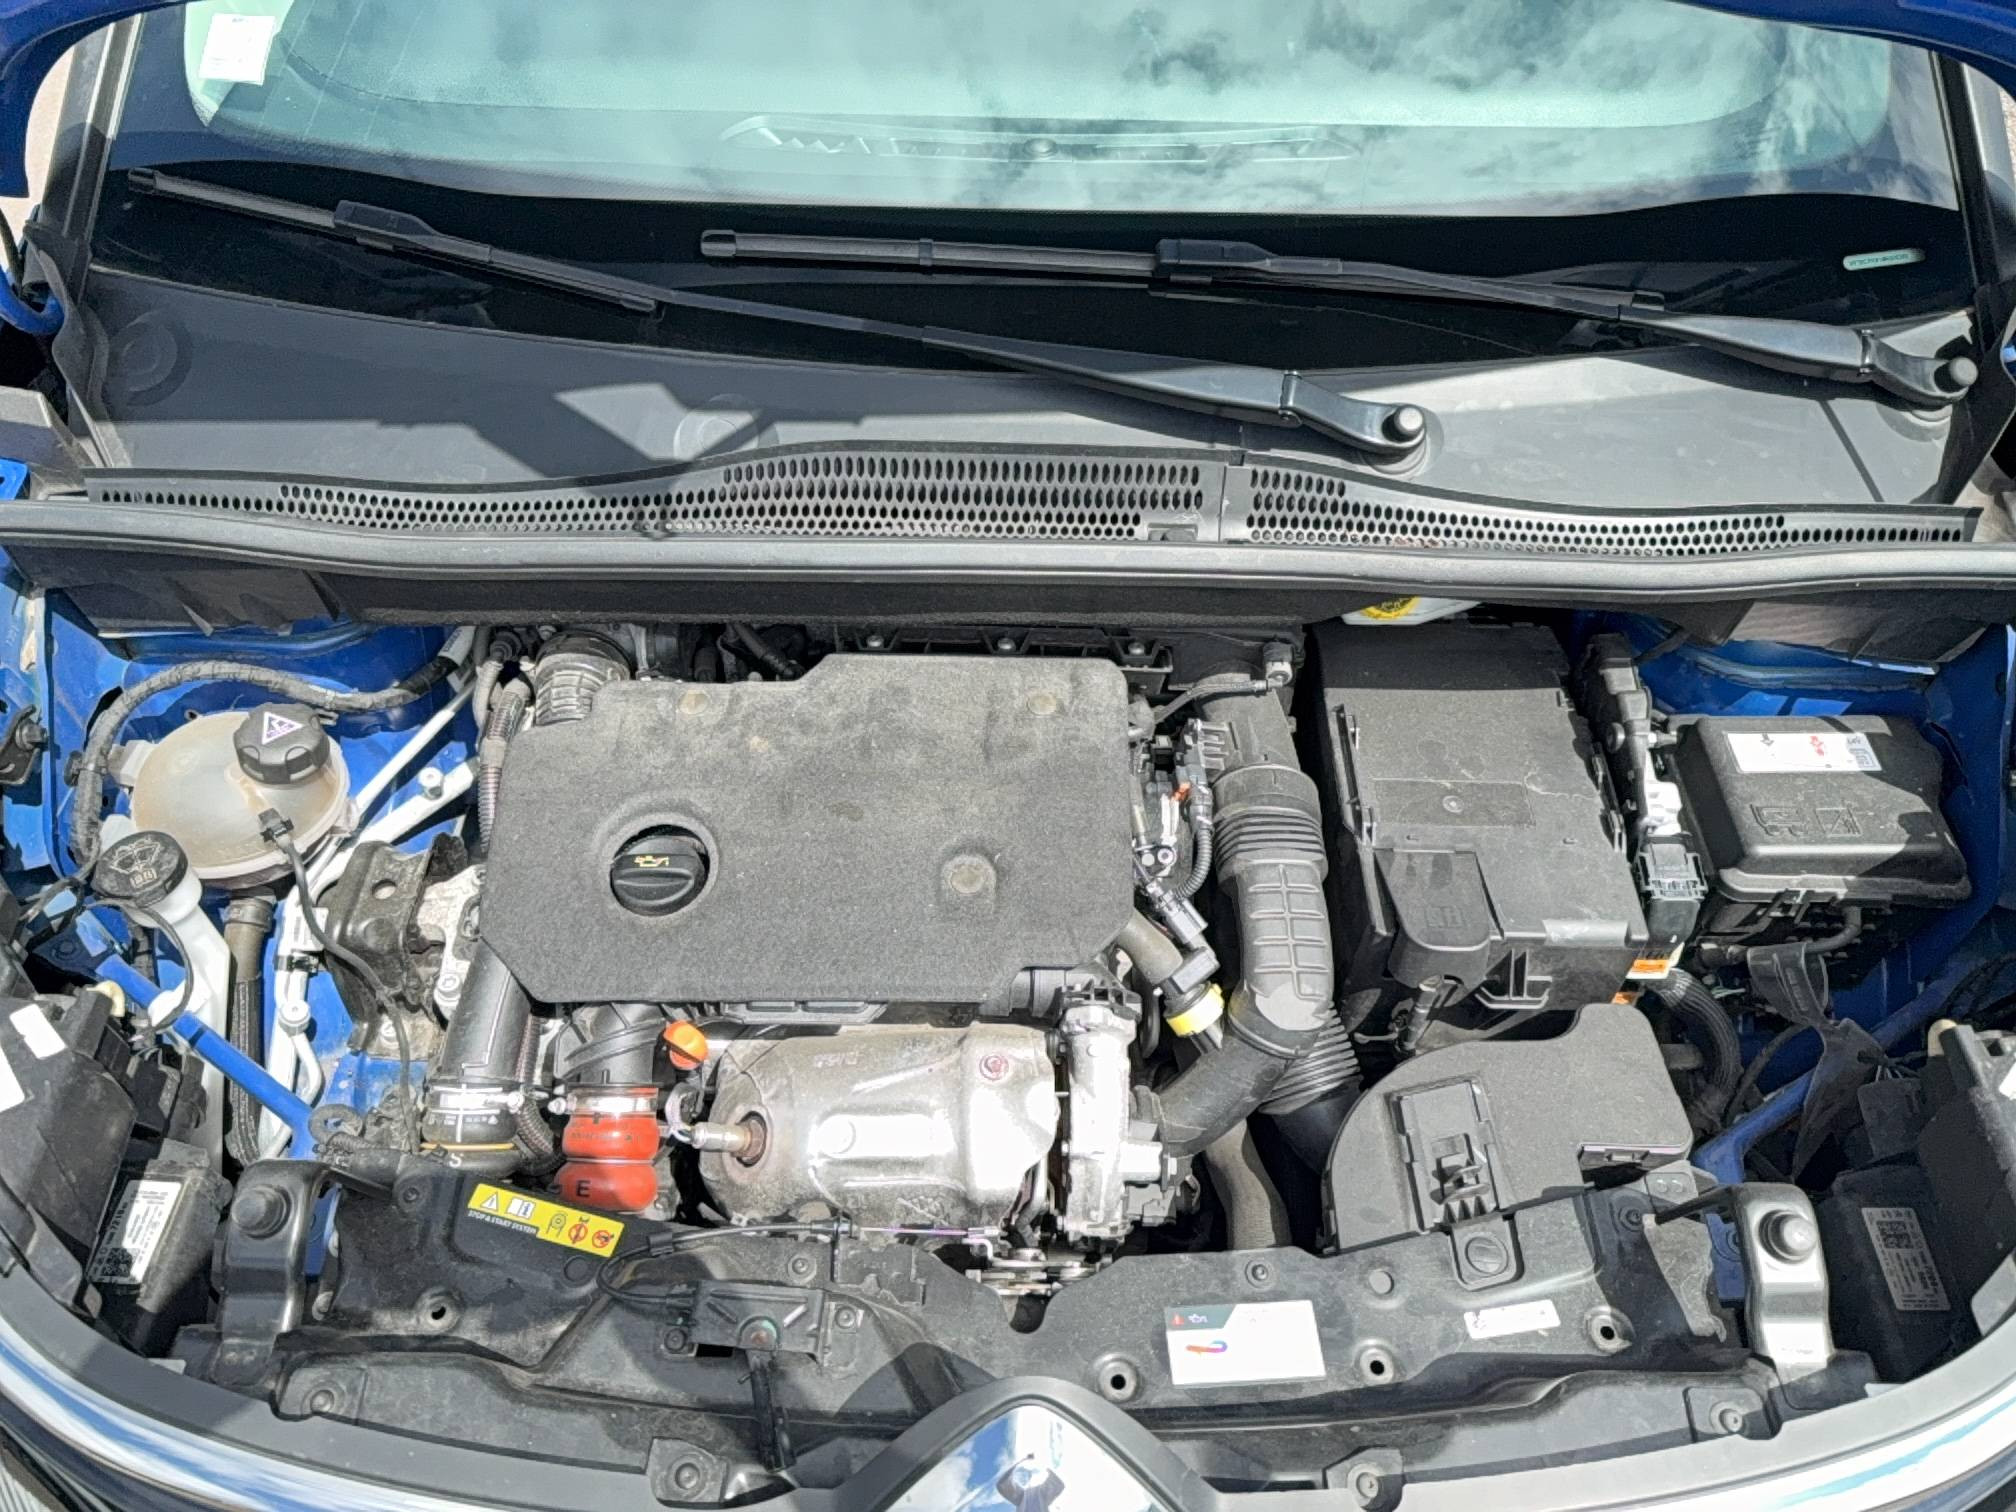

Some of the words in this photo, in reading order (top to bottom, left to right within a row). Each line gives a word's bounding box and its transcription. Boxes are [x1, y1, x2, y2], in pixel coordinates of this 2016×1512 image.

[577, 1180, 591, 1197] E
[468, 1210, 486, 1221] STOP
[491, 1216, 511, 1228] START
[512, 1222, 537, 1235] SYSTEM
